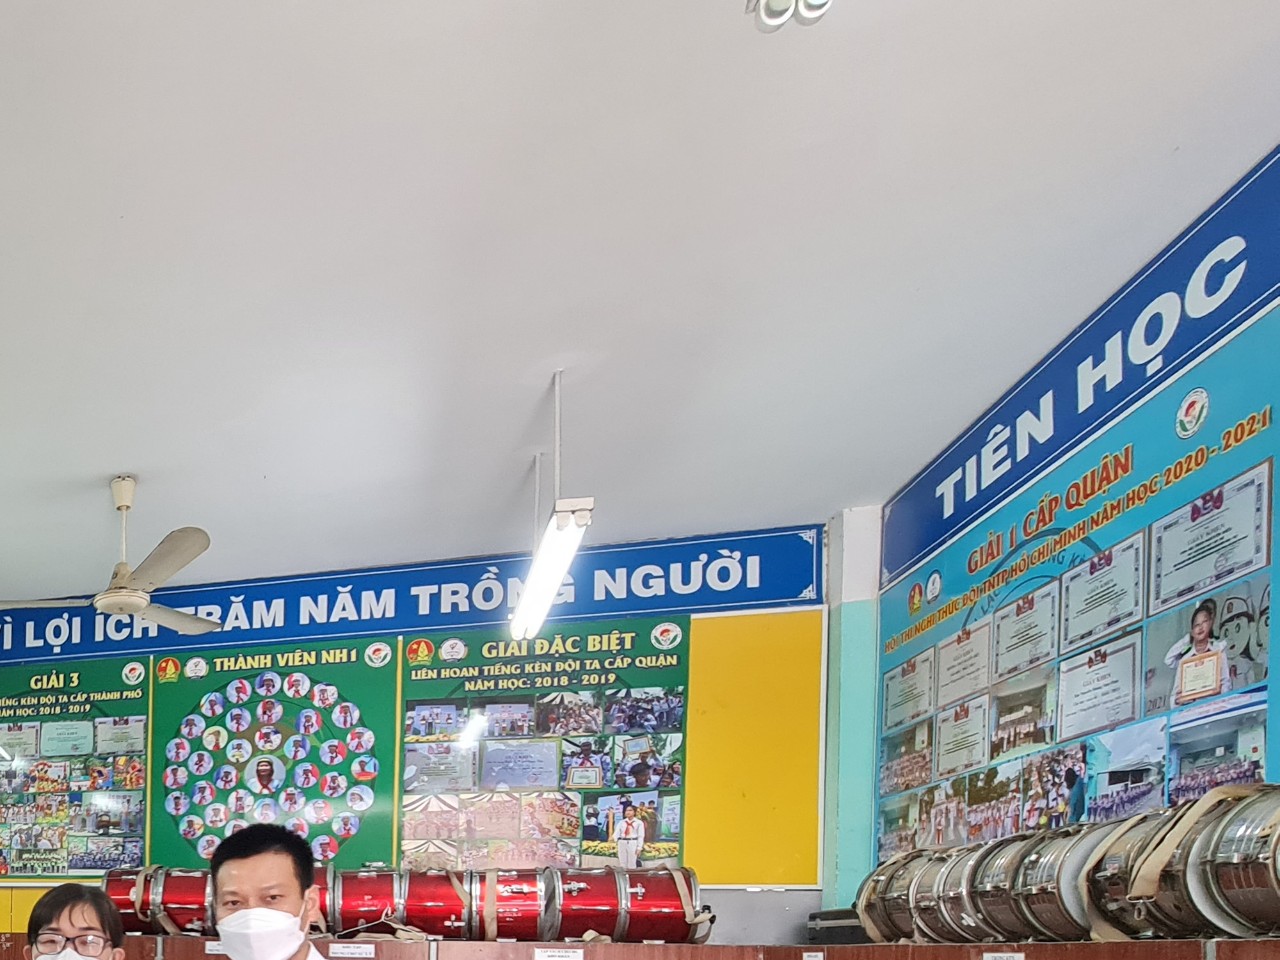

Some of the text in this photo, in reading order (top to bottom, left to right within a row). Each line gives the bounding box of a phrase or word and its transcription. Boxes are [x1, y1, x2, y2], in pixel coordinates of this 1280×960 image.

[935, 235, 1248, 520] TIÊN HỌC
[1052, 521, 1088, 554] MINH
[1124, 476, 1160, 509] HỌC
[1162, 445, 1209, 488] 2020
[1222, 405, 1272, 451] 2021
[967, 531, 1004, 575] GIẢI
[1022, 493, 1063, 538] CẤP
[1064, 443, 1134, 511] QUẬN
[25, 612, 81, 653] LỢI
[299, 584, 396, 625] NĂM
[593, 549, 760, 600] NGƯỜI
[533, 634, 580, 656] ĐẶC
[587, 630, 636, 654] BIỆT
[213, 654, 272, 672] THÀNH
[277, 649, 317, 667] VIÊN
[411, 667, 438, 681] LIÊN
[440, 666, 479, 679] HOAN
[481, 661, 521, 677] TIẾNG
[524, 661, 552, 675] KÈN
[584, 658, 601, 670] TA
[604, 653, 632, 669] CẤP
[634, 653, 678, 669] QUẬN
[30, 669, 80, 690] GIẢI 3
[464, 675, 495, 692] NĂM
[534, 675, 568, 687] 2018
[581, 673, 616, 685] 2019
[39, 705, 60, 715] 2018
[68, 703, 91, 714] 2019
[58, 693, 69, 703] TA
